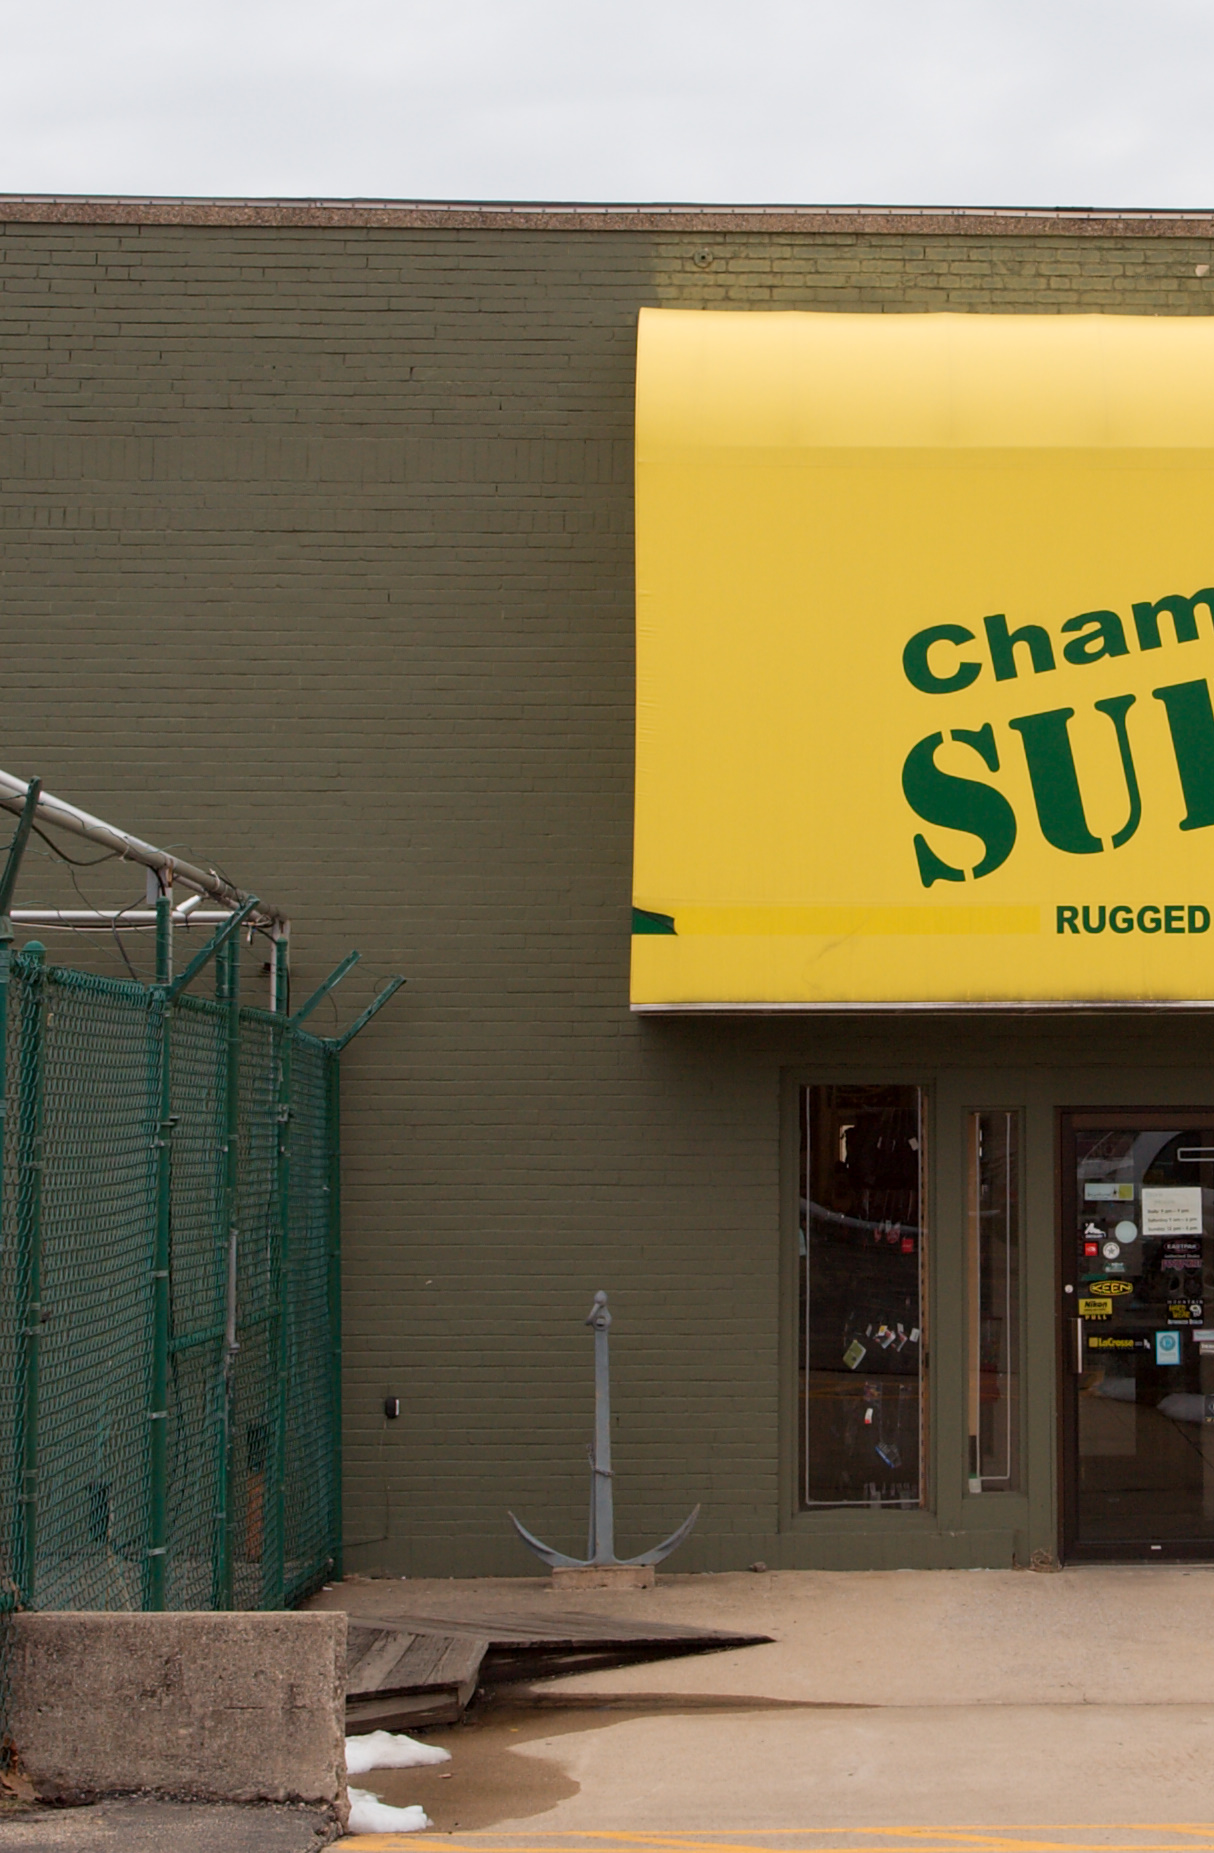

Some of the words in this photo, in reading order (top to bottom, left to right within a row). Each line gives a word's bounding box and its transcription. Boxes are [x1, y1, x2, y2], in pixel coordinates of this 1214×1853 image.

[1056, 905, 1211, 934] RUGGED
[1091, 1282, 1131, 1293] KEEN
[1085, 1301, 1107, 1309] Nikon
[1099, 1338, 1134, 1347] LaCrosse
